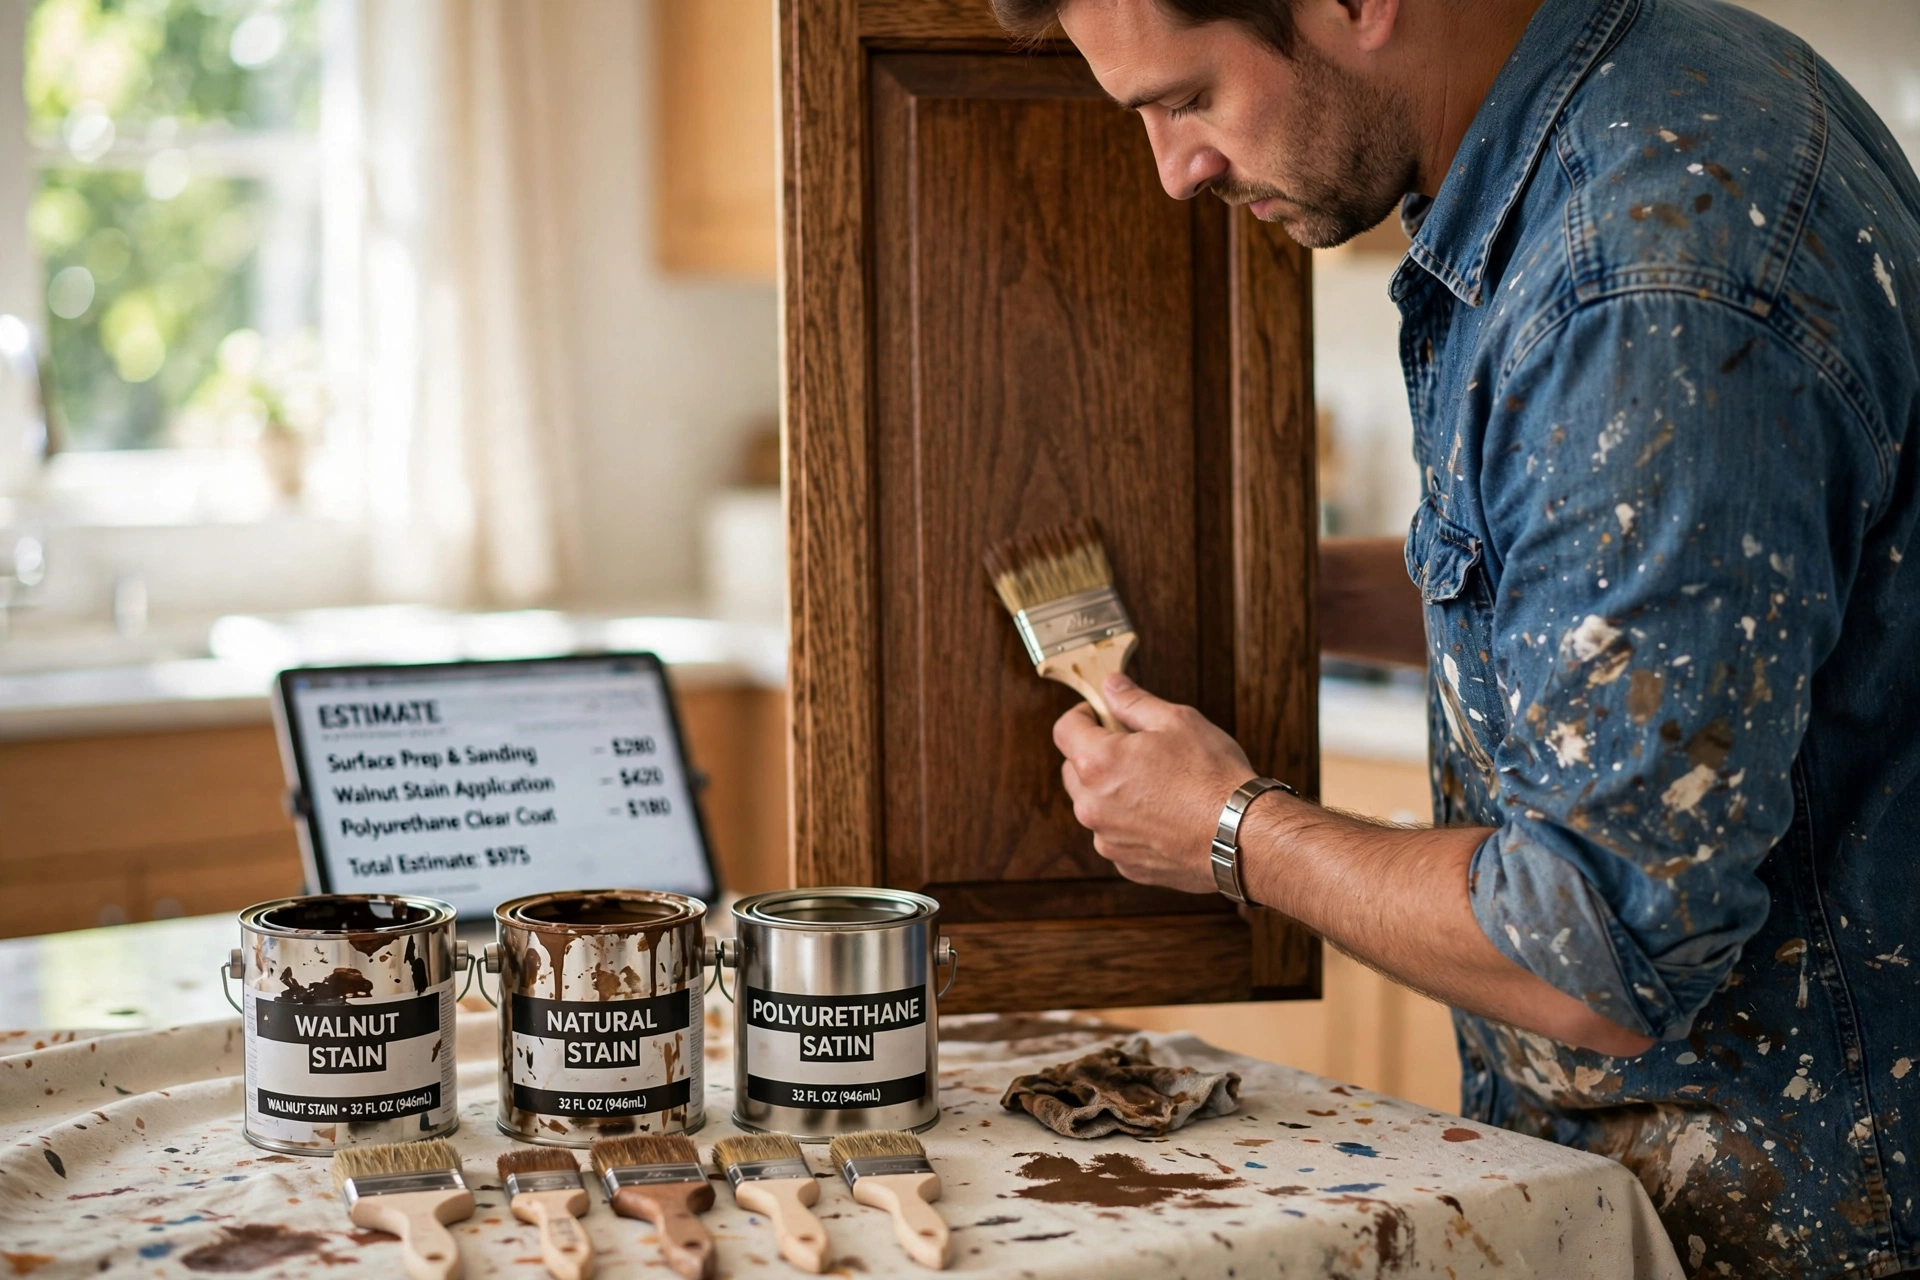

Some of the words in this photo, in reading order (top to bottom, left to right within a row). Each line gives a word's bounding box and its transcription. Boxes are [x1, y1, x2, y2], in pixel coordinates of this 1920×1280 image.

[318, 700, 440, 729] ESTIMATE
[327, 750, 396, 773] Surface
[400, 748, 443, 769] Prep
[446, 746, 461, 766] &
[465, 743, 538, 765] Sanding
[612, 736, 656, 757] $280
[333, 784, 399, 804] Walnut
[402, 780, 451, 800] Stain
[455, 774, 556, 799] Application
[340, 813, 461, 841] Polyurethane
[464, 809, 512, 830] Clear
[515, 806, 557, 826] Coat
[628, 797, 672, 818] $180
[348, 855, 394, 878] Total
[400, 851, 482, 876] Estimate:
[485, 845, 531, 867] $975
[294, 1012, 400, 1037] WALNUT
[547, 1008, 657, 1033] NATURAL
[752, 997, 919, 1027] POLYURETHANE
[312, 1044, 383, 1069] STAIN
[567, 1039, 637, 1064] STAIN
[802, 1034, 871, 1057] SATIN
[267, 1097, 306, 1115] WALNUT
[307, 1103, 339, 1116] STAIN
[350, 1103, 364, 1116] 32
[365, 1102, 378, 1115] FL
[379, 1100, 394, 1113] OZ
[396, 1092, 432, 1113] (946mL)
[558, 1097, 571, 1110] 32
[573, 1098, 586, 1111] FL
[587, 1098, 603, 1111] OZ
[605, 1095, 647, 1112] (946mL)
[791, 1088, 805, 1102] 32
[807, 1090, 820, 1103] FL
[821, 1089, 837, 1103] OZ
[839, 1088, 881, 1105] (946mL)
